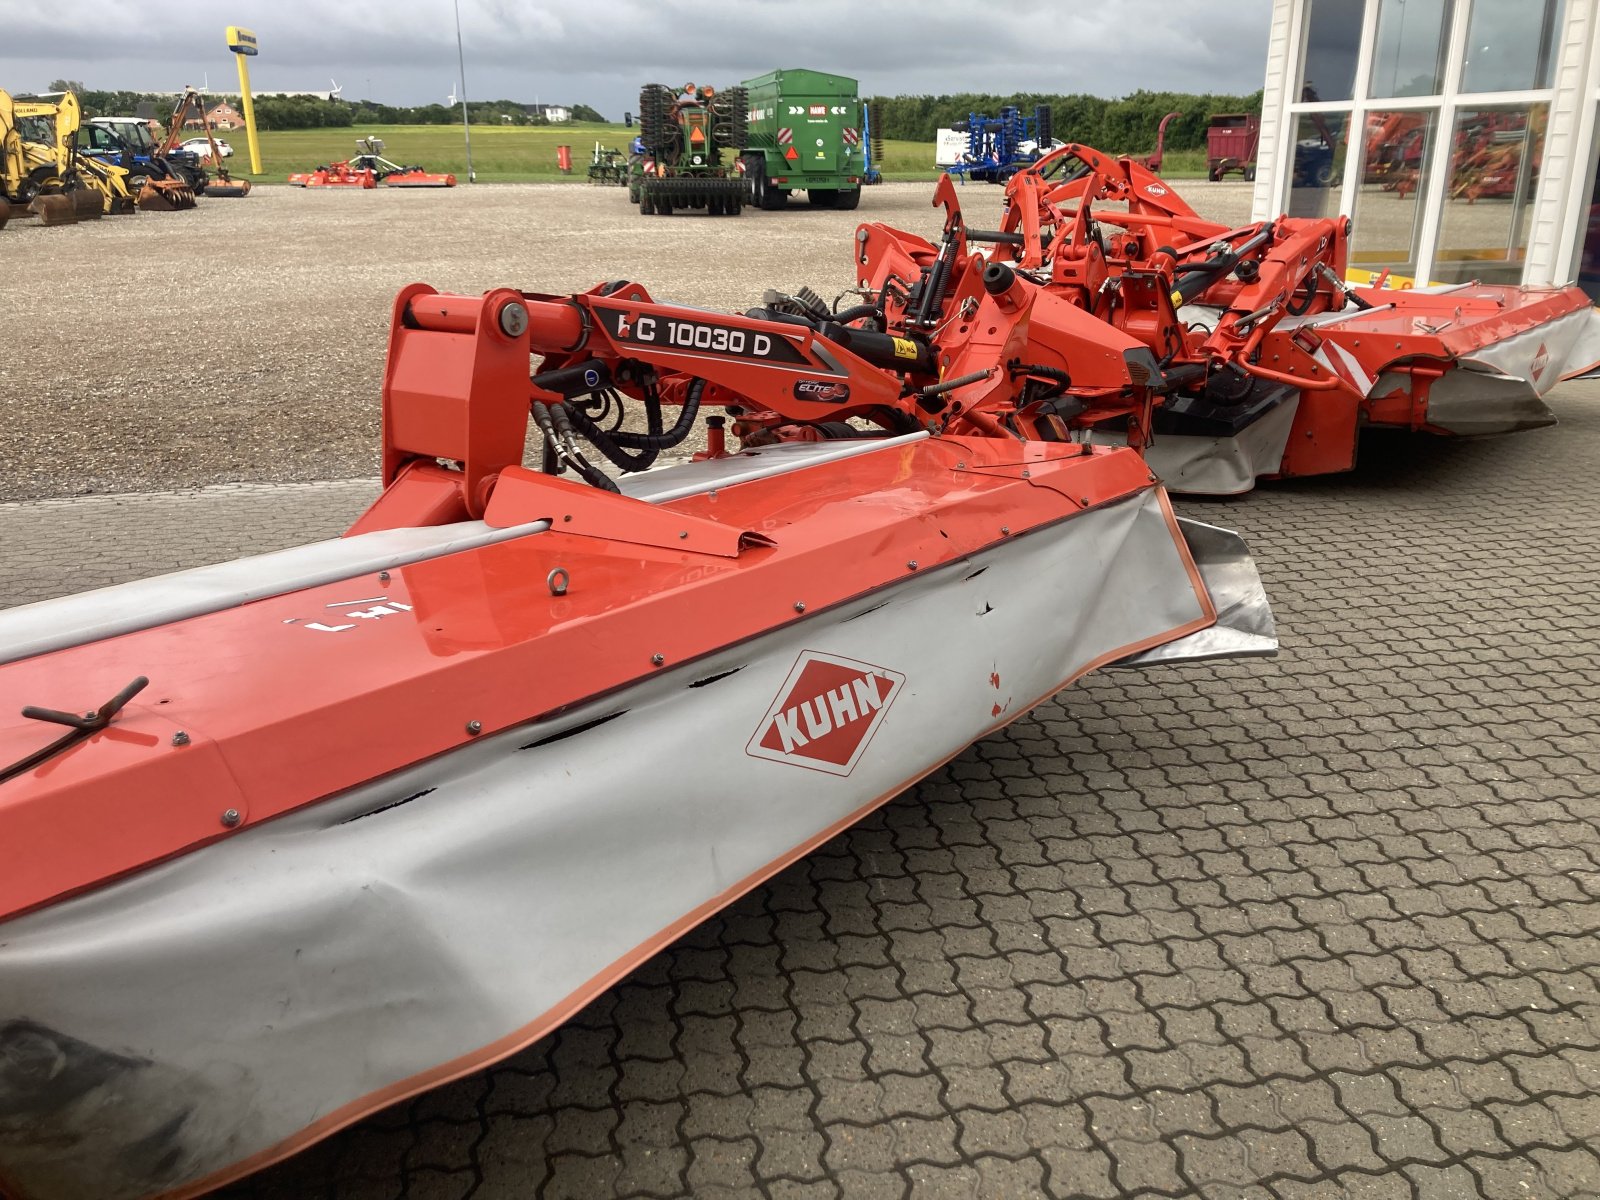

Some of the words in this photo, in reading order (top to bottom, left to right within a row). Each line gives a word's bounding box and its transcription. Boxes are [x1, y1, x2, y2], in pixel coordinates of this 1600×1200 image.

[809, 106, 826, 115] HAWE
[668, 322, 746, 354] 10030
[753, 334, 772, 356] D
[774, 671, 884, 755] KUHN
